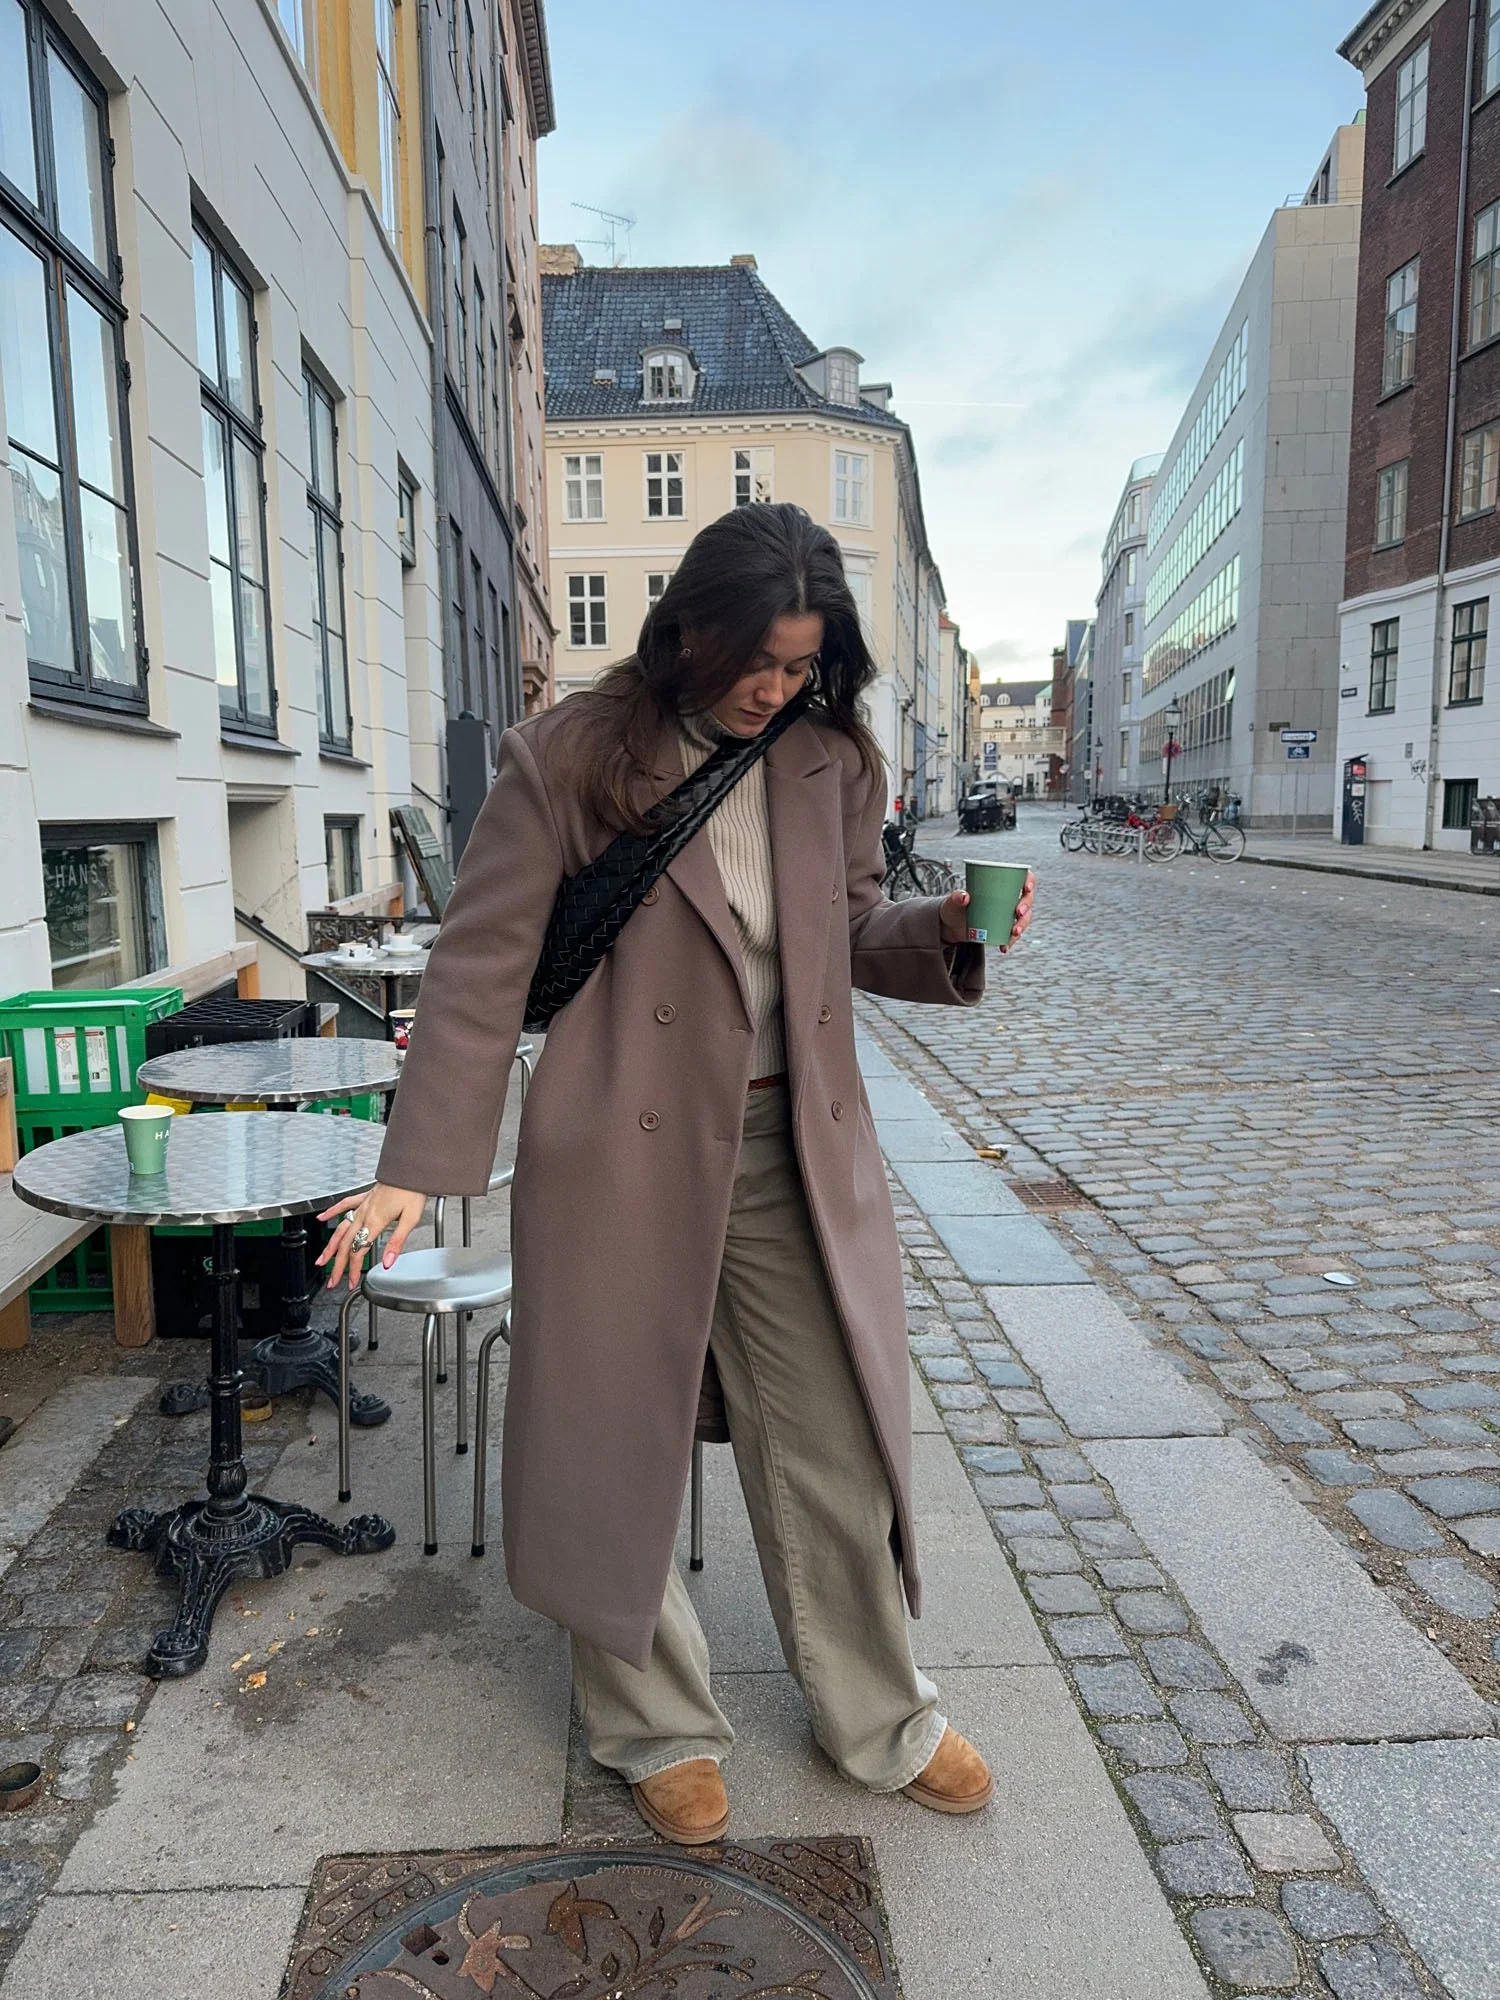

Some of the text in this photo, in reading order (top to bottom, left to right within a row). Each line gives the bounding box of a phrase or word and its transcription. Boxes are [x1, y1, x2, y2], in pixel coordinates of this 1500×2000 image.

[986, 743, 995, 754] P
[55, 863, 98, 888] HANS
[775, 1916, 825, 1960] FURNES
